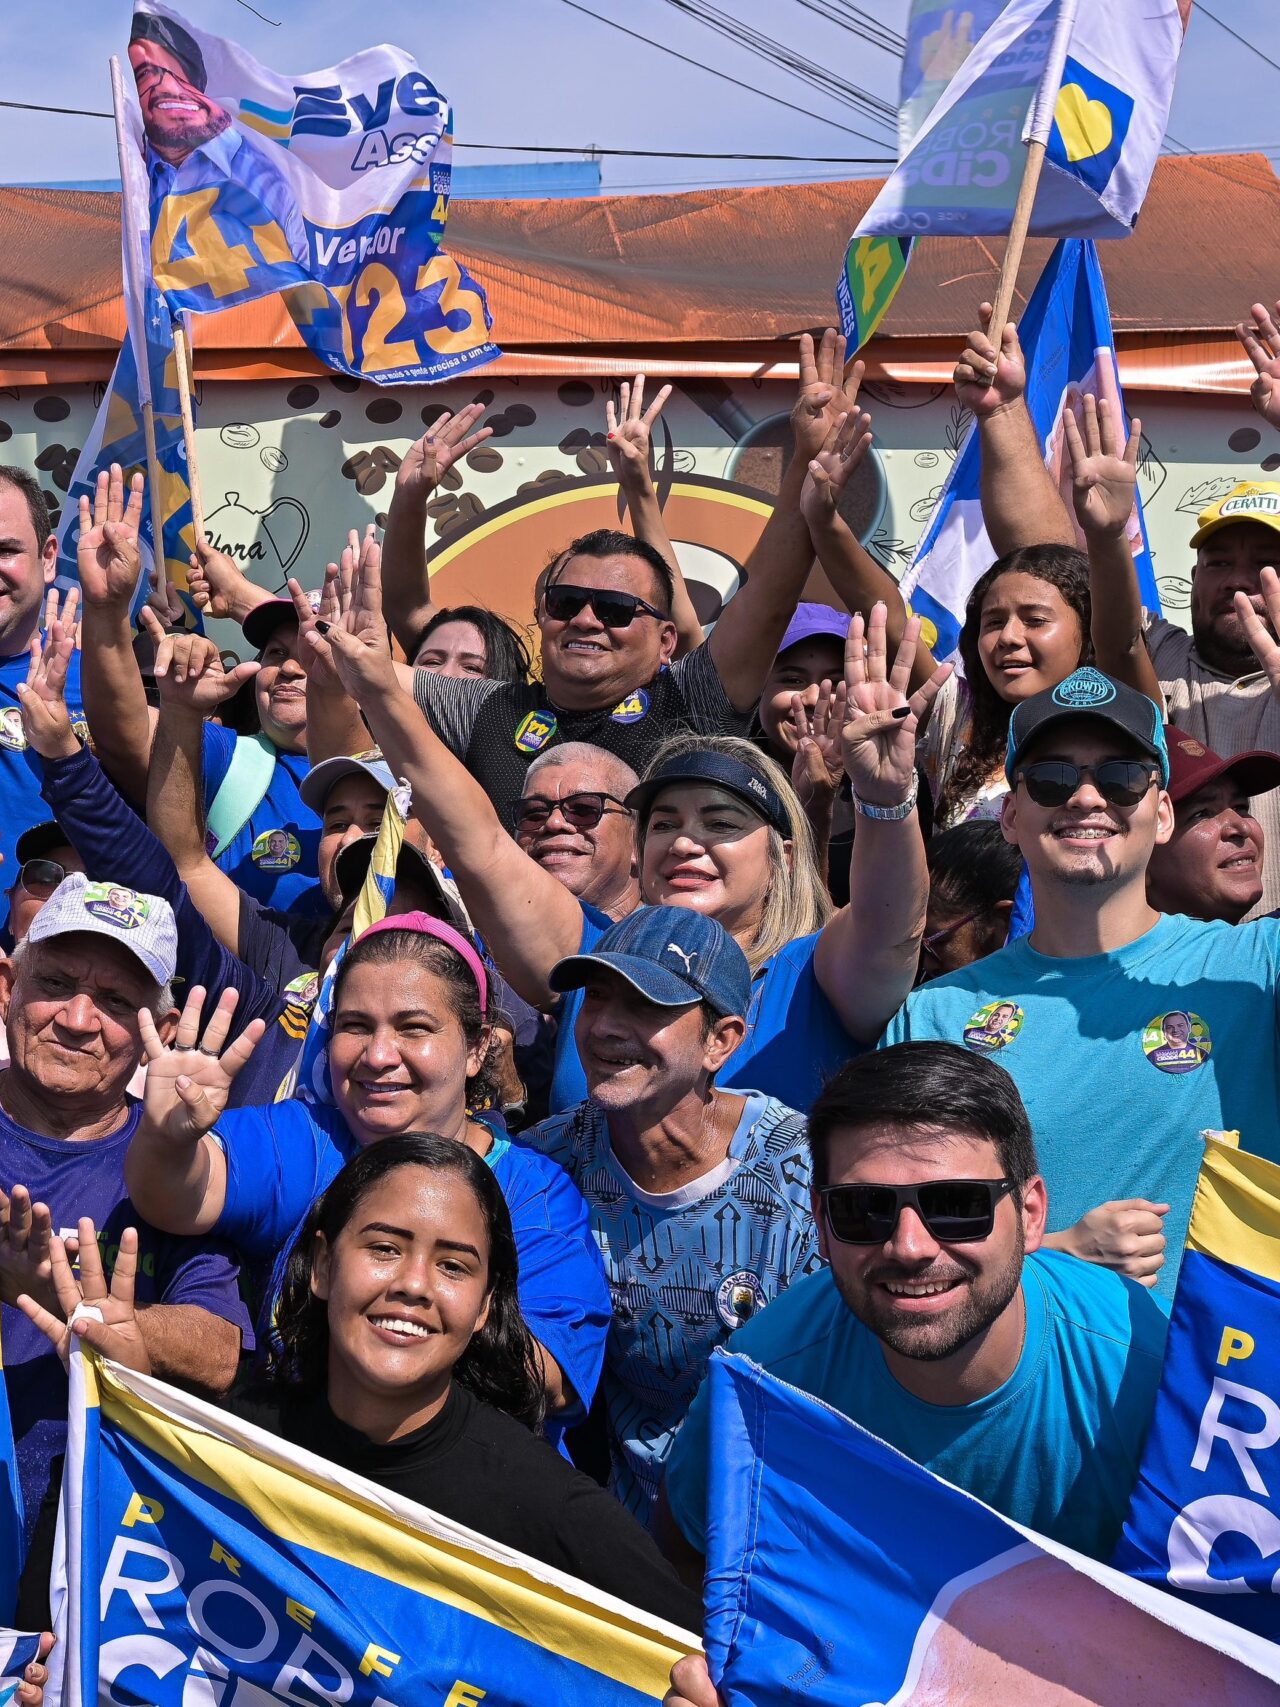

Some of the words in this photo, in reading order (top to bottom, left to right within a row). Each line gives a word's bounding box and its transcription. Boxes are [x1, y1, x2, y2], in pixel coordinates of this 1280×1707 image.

[290, 72, 448, 137] Eve
[351, 128, 447, 171] Ass
[429, 356, 460, 375] precisa
[469, 346, 483, 359] um
[1225, 496, 1278, 511] CERATTI
[1060, 680, 1108, 696] GROWTH
[1178, 1048, 1196, 1059] 44
